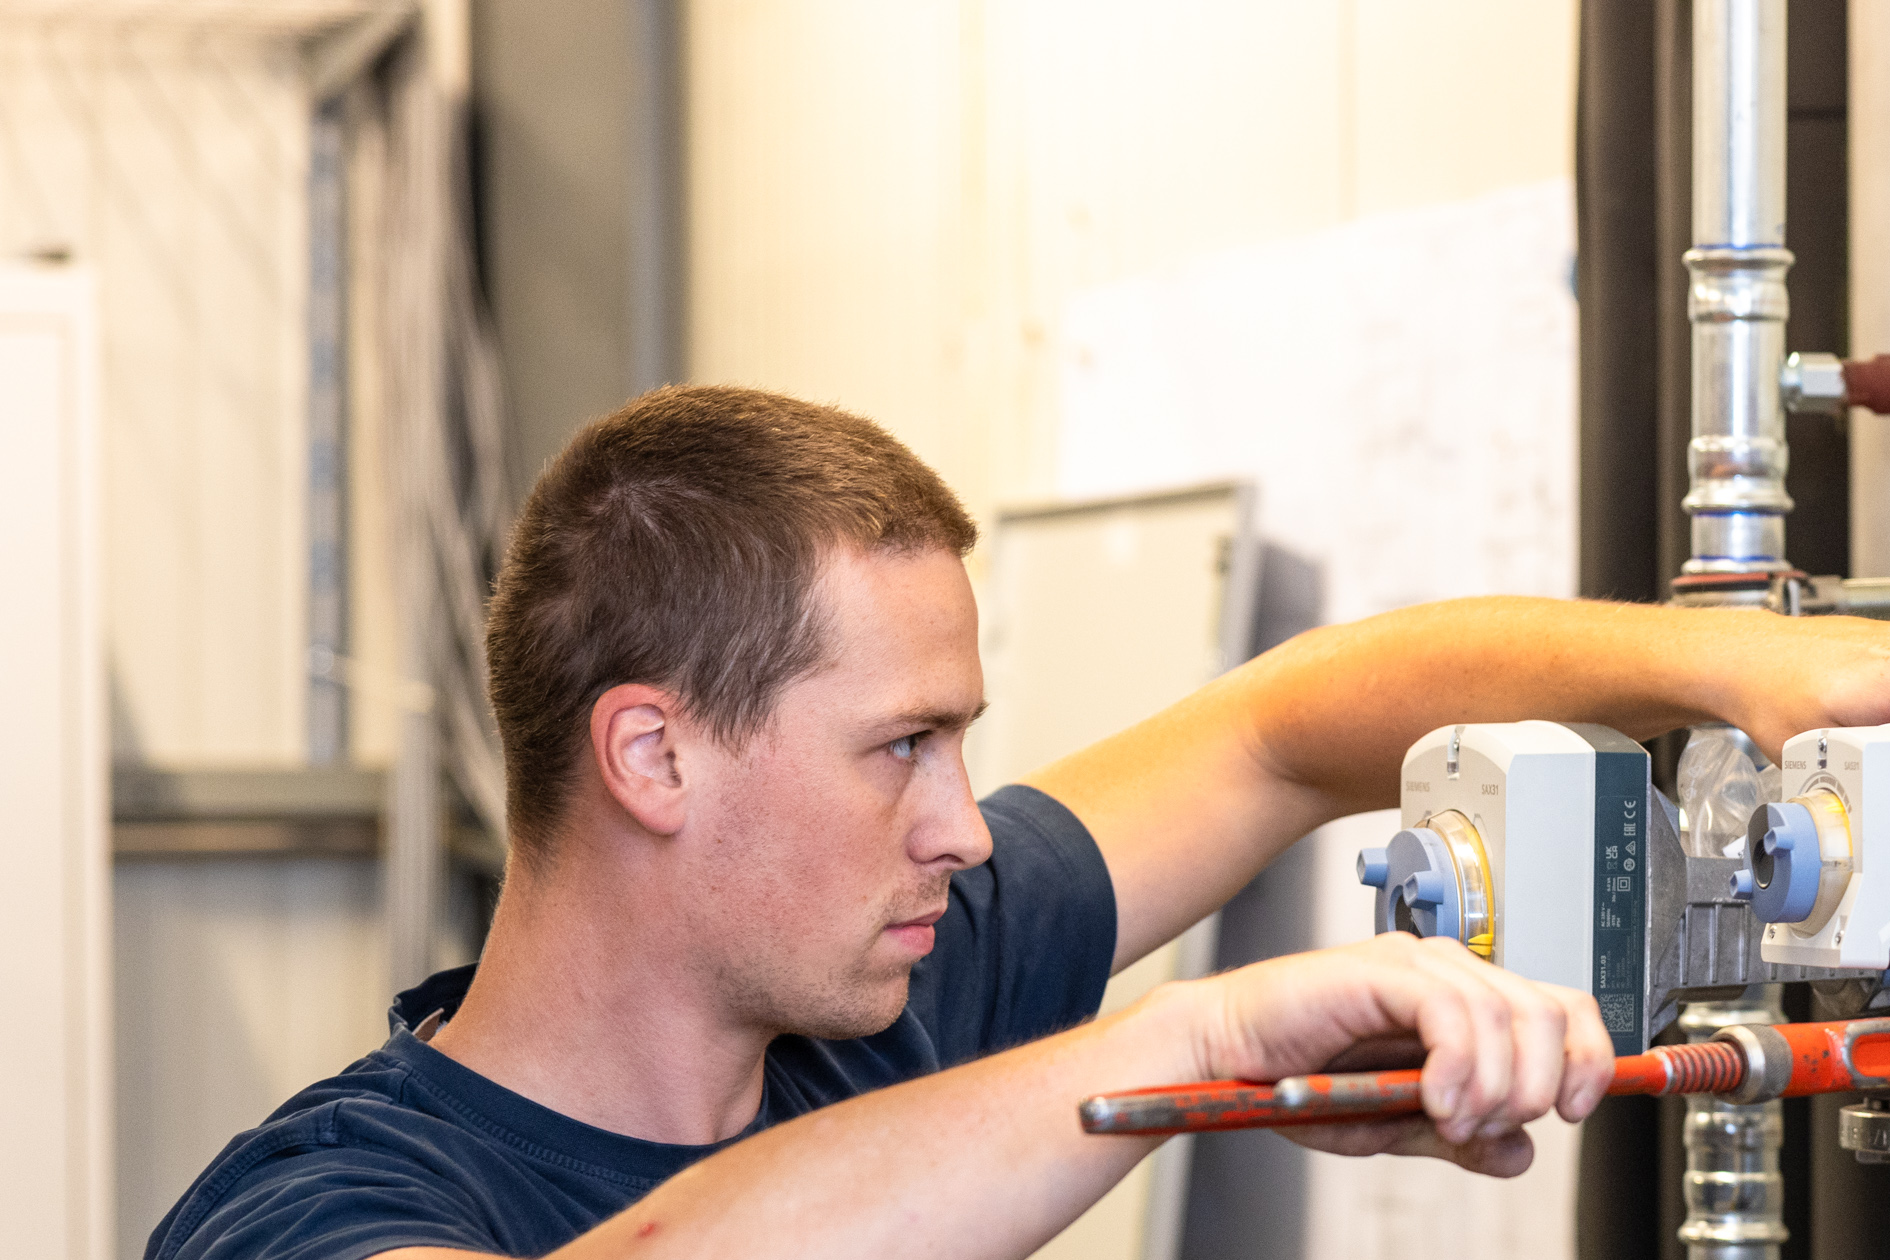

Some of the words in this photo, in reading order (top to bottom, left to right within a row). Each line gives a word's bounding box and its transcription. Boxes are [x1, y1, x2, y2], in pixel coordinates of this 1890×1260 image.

[1784, 760, 1807, 770] SIEMENS
[1405, 780, 1431, 793] SIEMENS
[1481, 783, 1499, 796] SAX31
